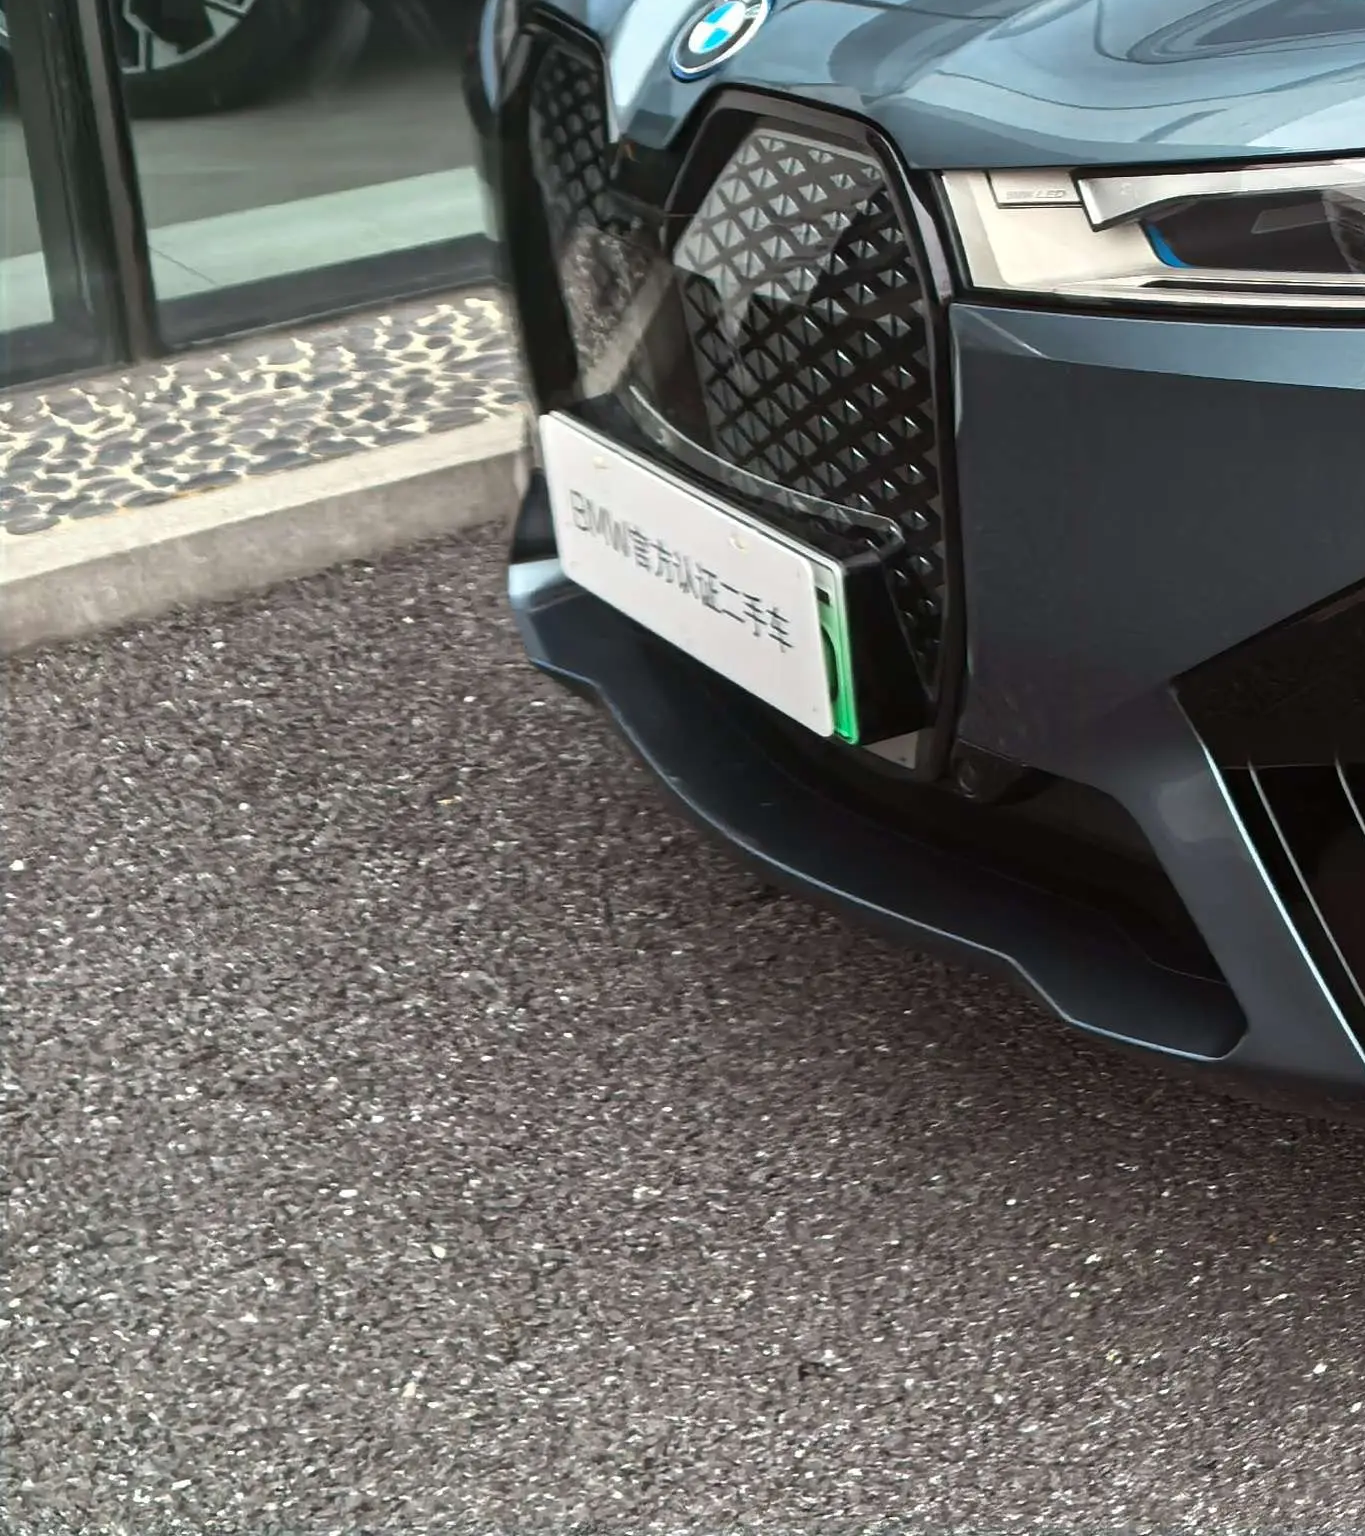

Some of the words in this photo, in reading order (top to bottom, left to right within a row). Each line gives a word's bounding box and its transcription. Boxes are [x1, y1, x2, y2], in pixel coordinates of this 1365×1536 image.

[568, 488, 794, 654] BMW官方认证二手车
